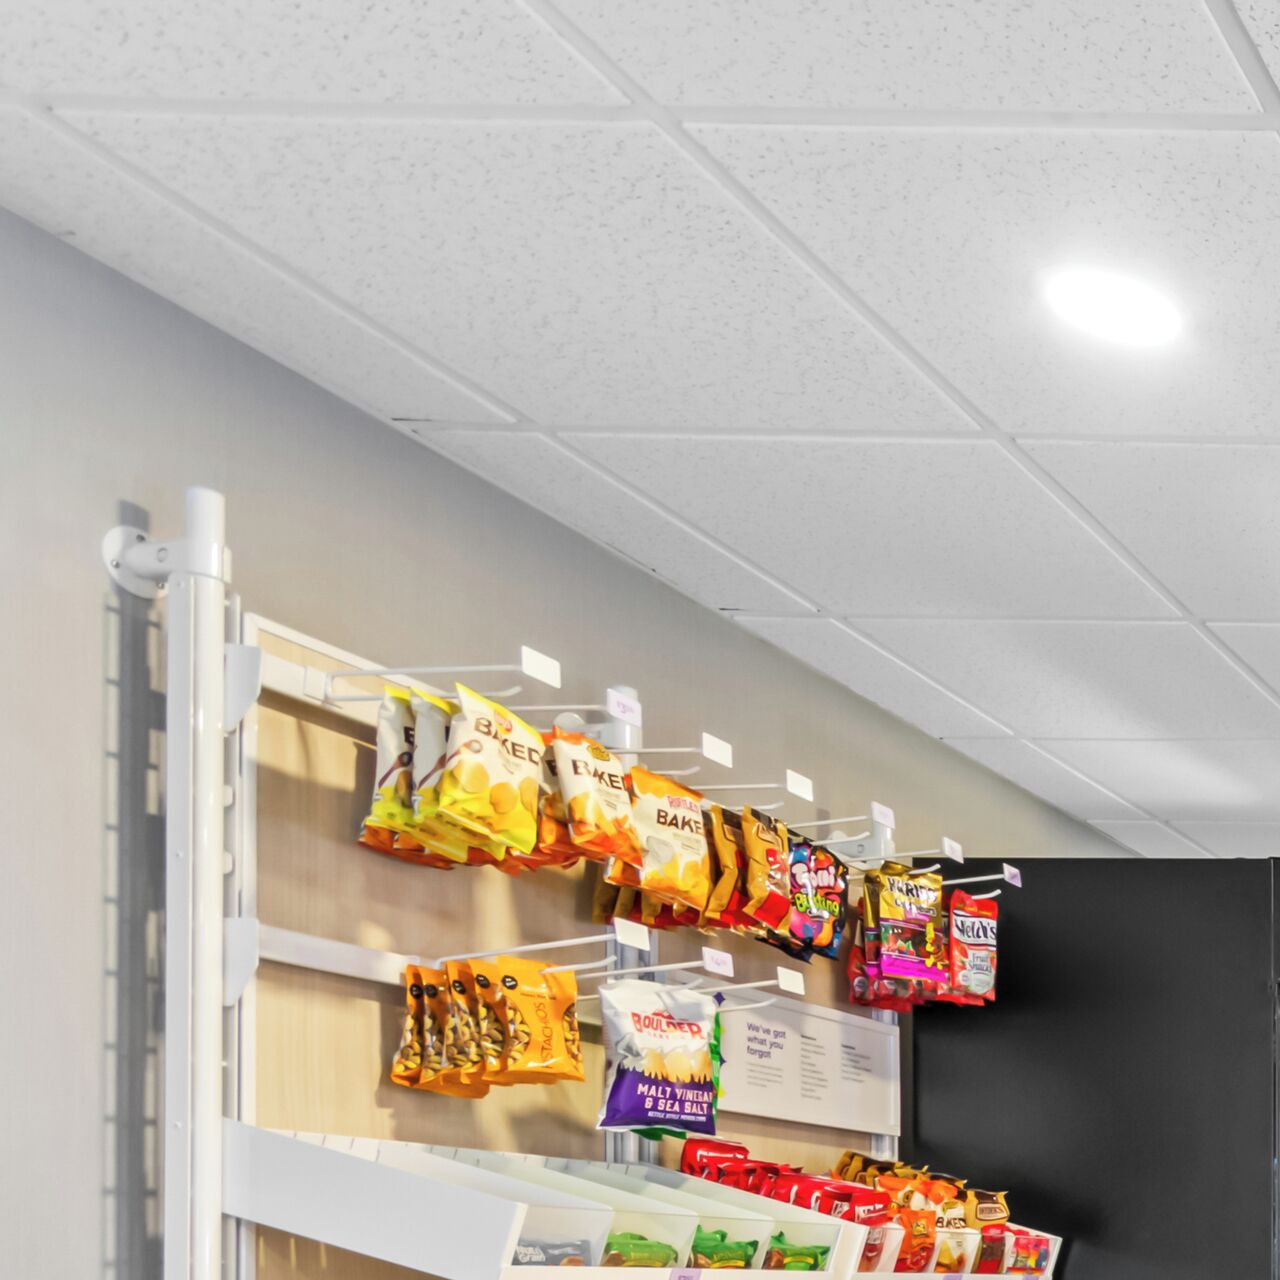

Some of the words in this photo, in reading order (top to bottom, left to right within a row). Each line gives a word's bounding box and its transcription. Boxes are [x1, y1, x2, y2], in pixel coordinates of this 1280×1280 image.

[656, 808, 704, 836] BAKE
[954, 918, 997, 940] Welch's
[631, 1012, 706, 1040] BOULDER
[746, 1022, 771, 1036] We've
[773, 1028, 786, 1040] got
[746, 1036, 767, 1047] what
[769, 1040, 783, 1051] you
[746, 1046, 772, 1060] forgot
[637, 1083, 671, 1099] MALT
[644, 1097, 654, 1109] &
[657, 1099, 680, 1113] SEA
[684, 1101, 708, 1115] SALT
